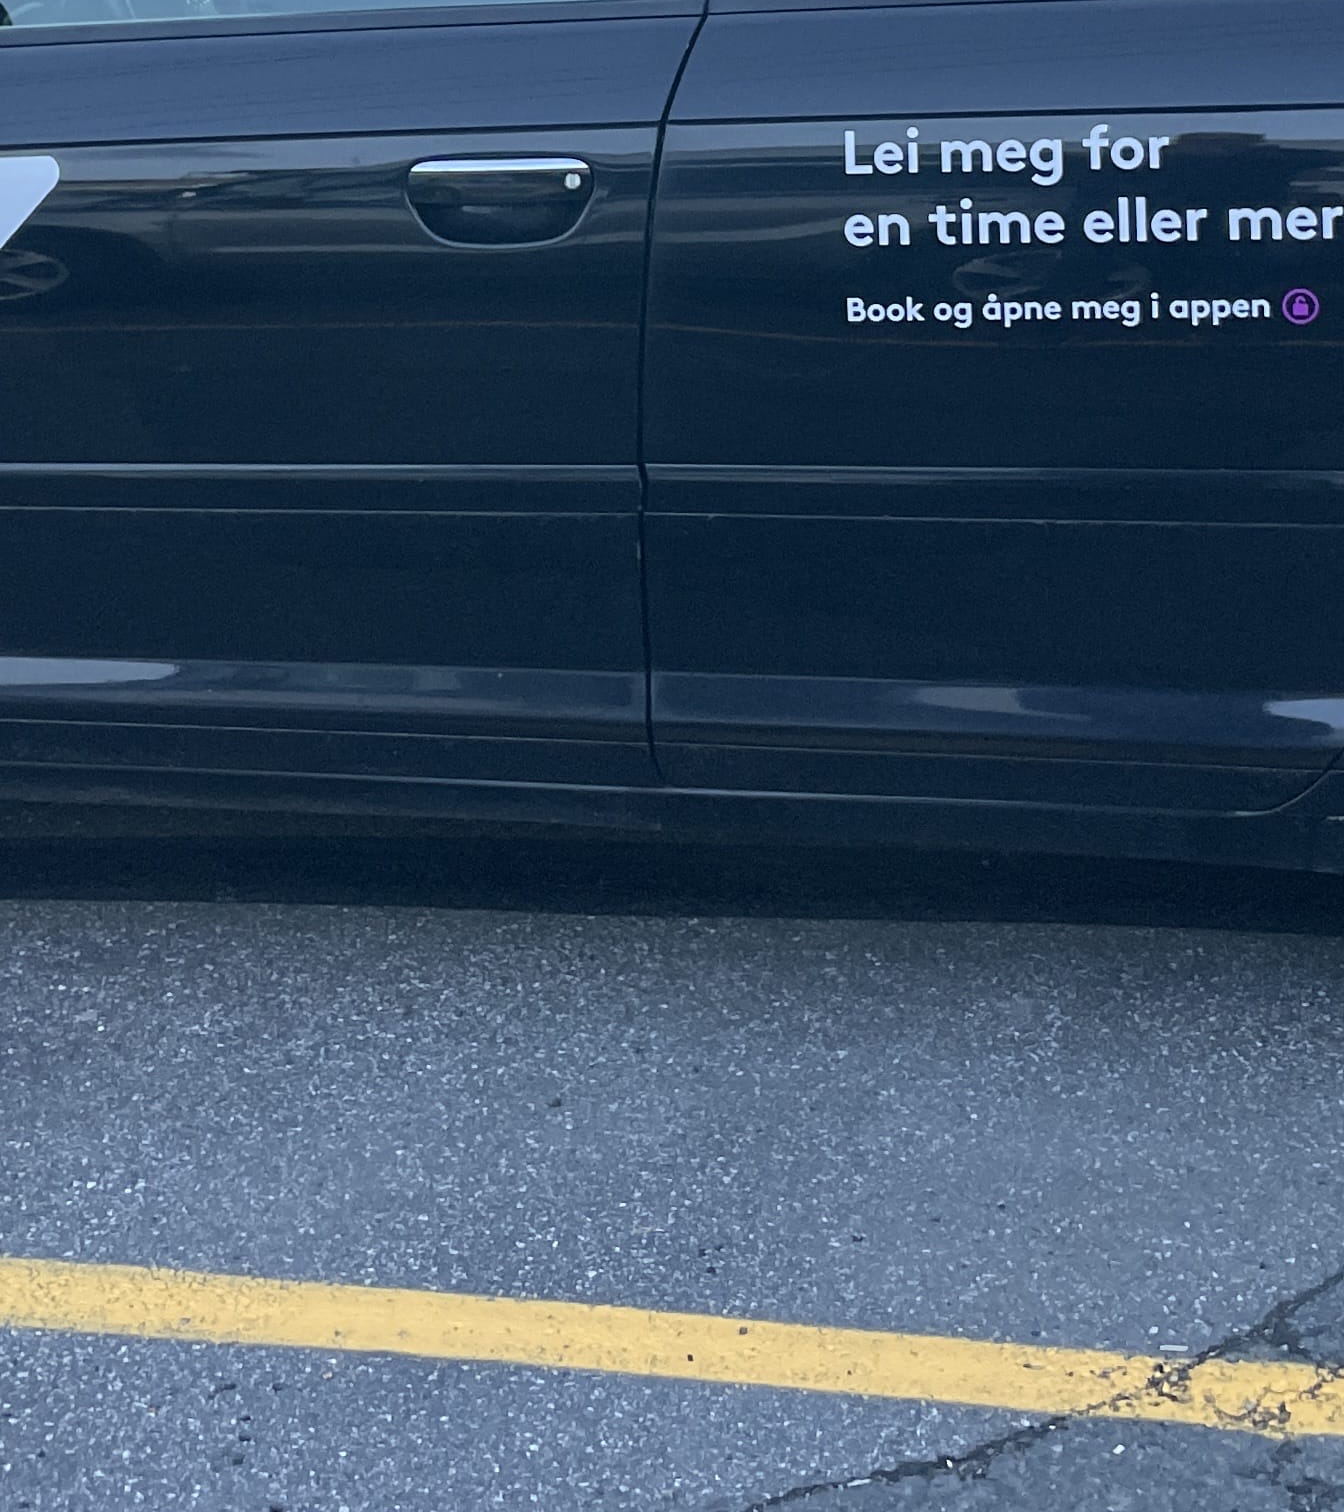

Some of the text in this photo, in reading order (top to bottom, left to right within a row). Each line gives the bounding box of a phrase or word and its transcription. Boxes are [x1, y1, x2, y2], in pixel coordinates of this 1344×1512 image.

[844, 123, 1170, 187] Lei meg for
[844, 196, 1344, 247] en time eller mer
[846, 292, 1270, 329] Book og åpne meg i appen
